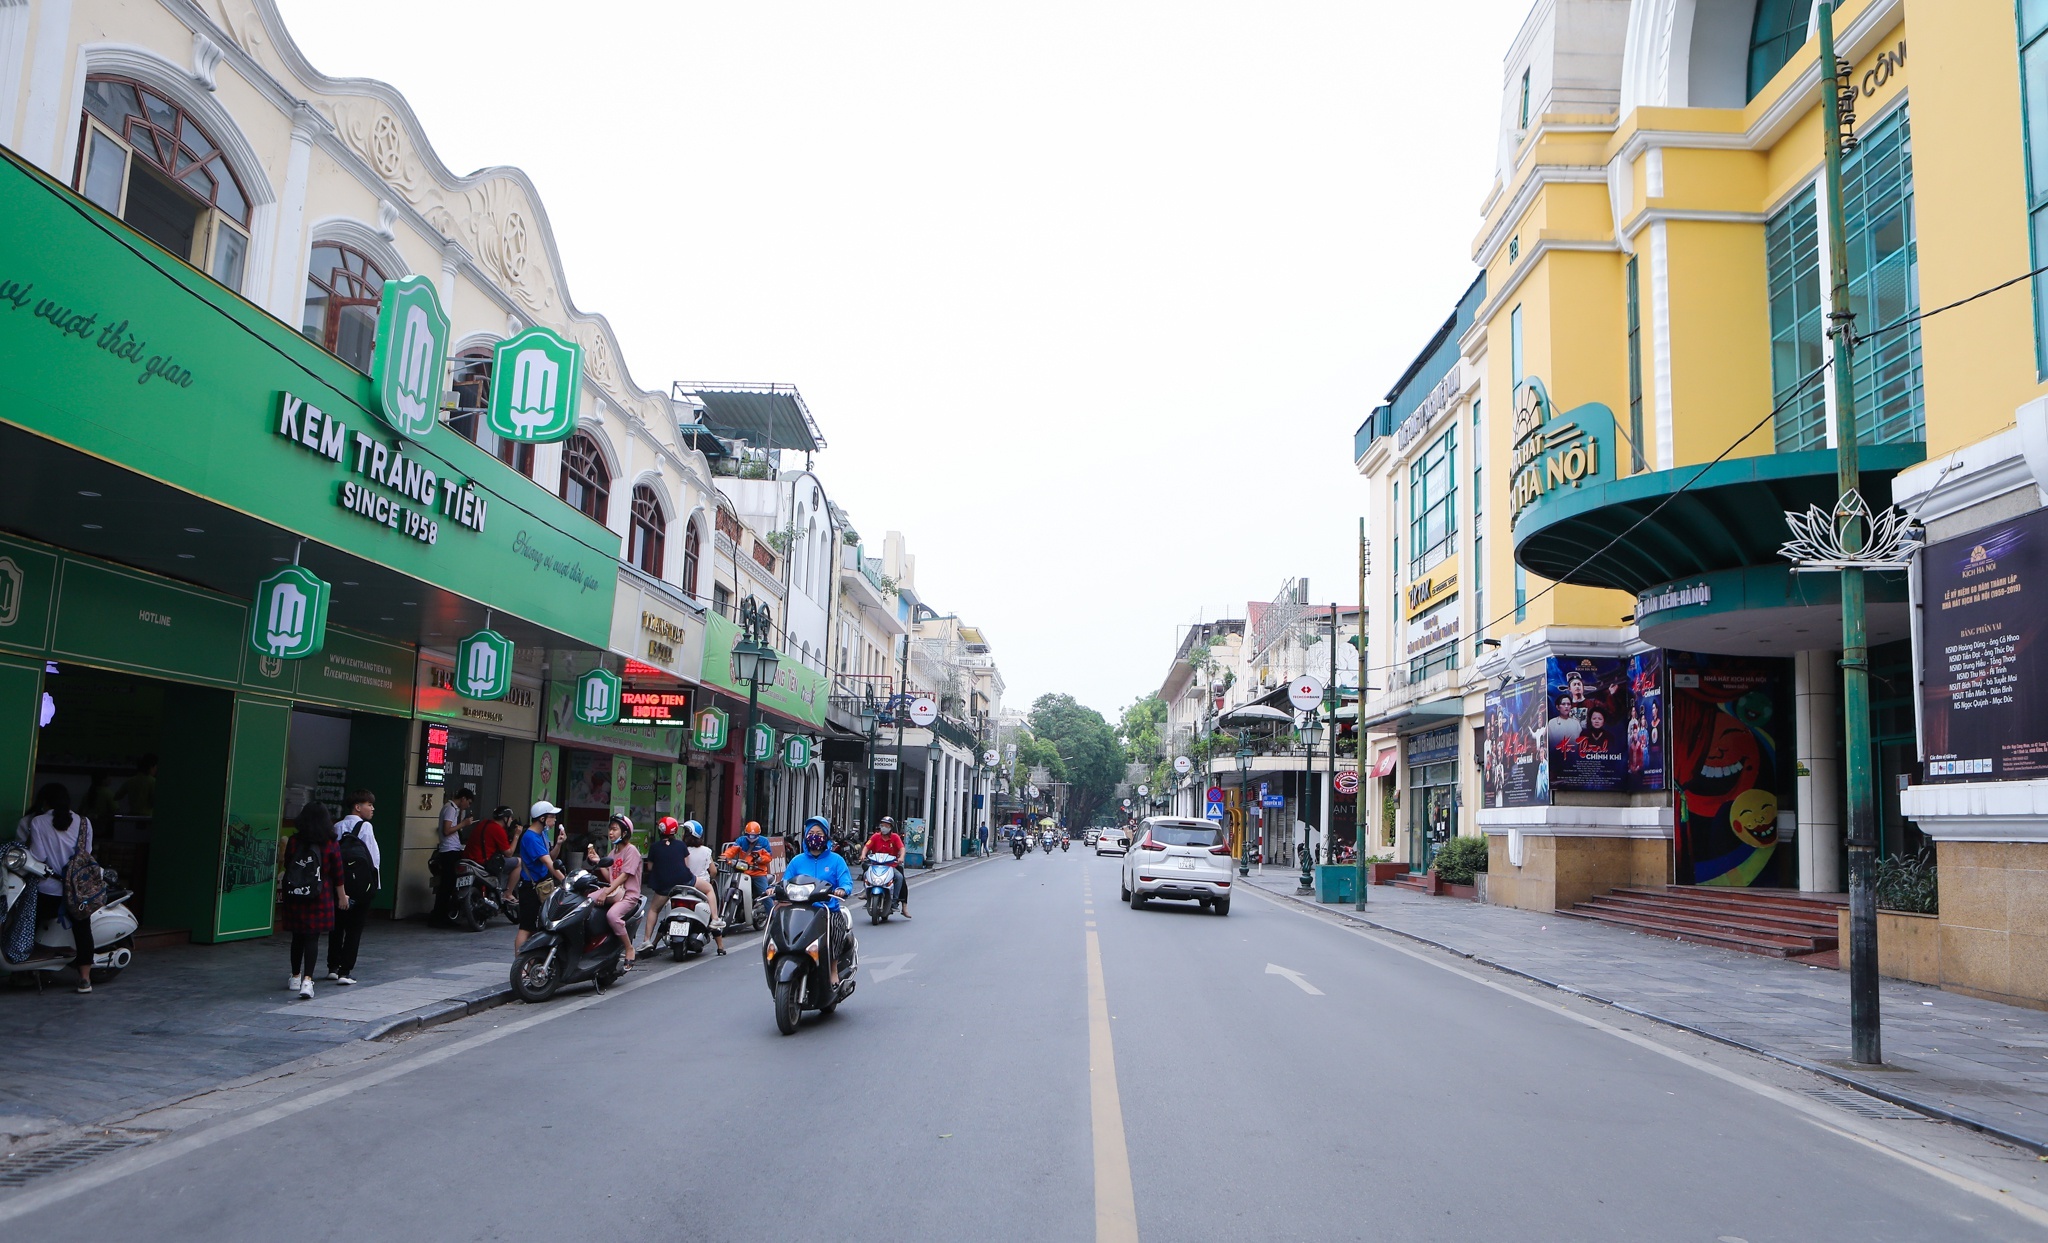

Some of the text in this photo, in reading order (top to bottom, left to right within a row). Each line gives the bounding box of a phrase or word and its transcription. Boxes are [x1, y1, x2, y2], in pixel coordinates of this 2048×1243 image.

[138, 356, 193, 388] gian
[276, 391, 488, 533] KEM TRÀNG TIỀN
[1546, 436, 1598, 488] NỘI
[342, 481, 438, 545] SINCE 1958
[580, 575, 598, 594] gian
[139, 610, 171, 627] HOTLINE
[622, 693, 685, 706] TRANG TIEN
[633, 705, 671, 718] HOTEL
[1586, 752, 1621, 760] CHÍNH KHÍ
[1336, 771, 1358, 782] HIGHLAN
